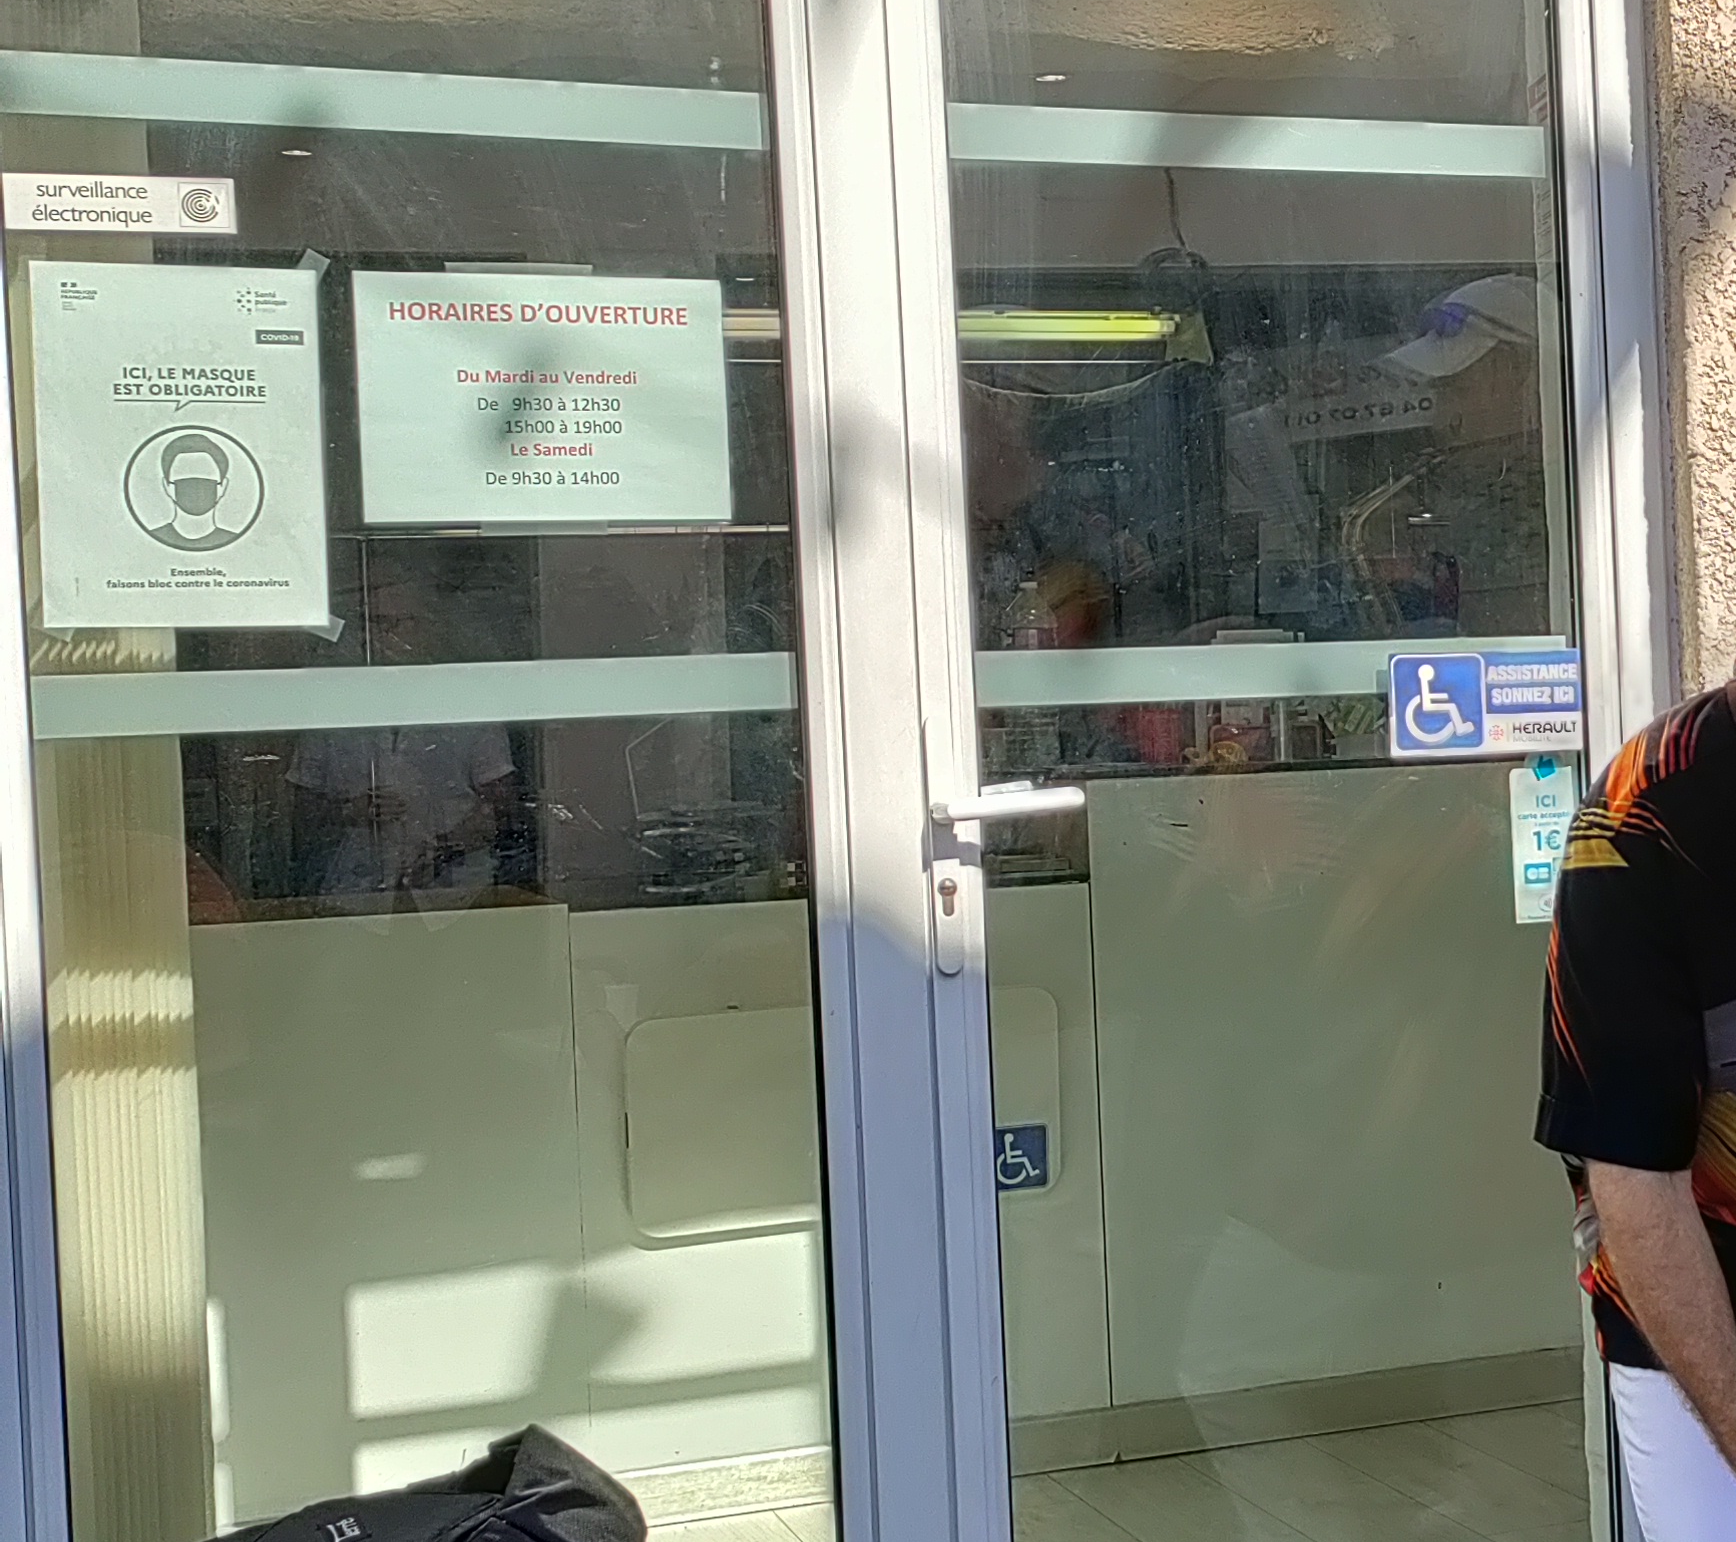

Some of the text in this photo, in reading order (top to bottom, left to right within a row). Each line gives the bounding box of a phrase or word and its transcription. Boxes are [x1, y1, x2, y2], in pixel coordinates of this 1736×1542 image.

[36, 181, 149, 200] surveillance
[32, 204, 153, 228] électronique
[388, 301, 514, 323] HORAIRES
[122, 366, 257, 384] ICI, LE MASQUE
[456, 369, 638, 385] Du Mardi au Vendredi
[113, 383, 267, 398] EST OBLIGATOIRE
[477, 396, 621, 412] De 9h30 à 12h30
[504, 419, 623, 435] 15h00 à 19h00
[510, 442, 593, 457] Le Samedi
[486, 470, 620, 485] De 9h30 à 14h00
[147, 578, 173, 589] bloc
[174, 579, 211, 588] contre
[213, 578, 224, 588] le
[225, 577, 290, 588] coronavirus
[1486, 663, 1578, 682] ASSISTANCE
[1491, 685, 1575, 707] SONNEZ ICI
[1535, 794, 1557, 808] ICI
[1532, 829, 1562, 851] 1€
